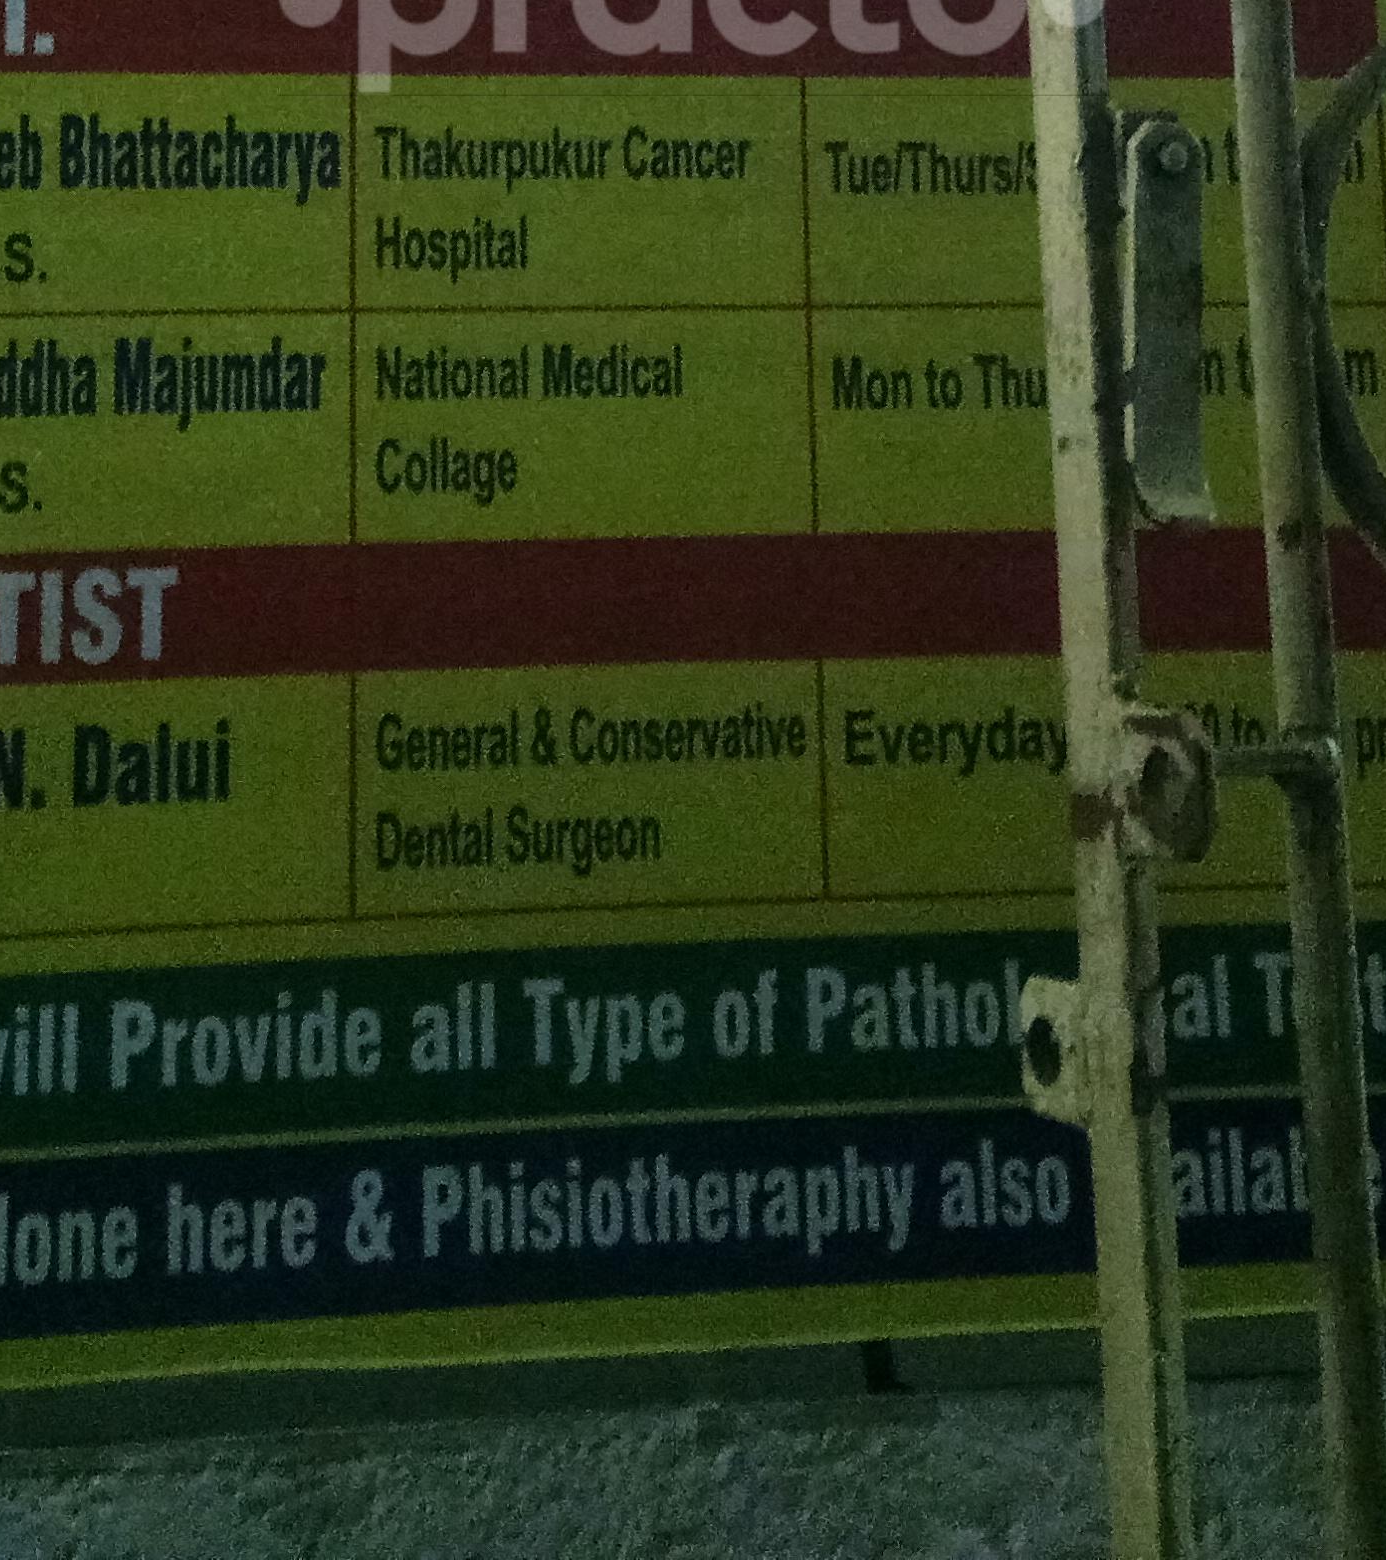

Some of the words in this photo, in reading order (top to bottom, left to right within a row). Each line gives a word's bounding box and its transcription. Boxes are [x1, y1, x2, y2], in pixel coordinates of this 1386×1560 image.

[59, 112, 341, 207] Bhattacharya
[374, 126, 612, 191] Thakurpukur
[622, 126, 751, 180] Cancer
[375, 217, 528, 282] Hospital
[113, 336, 326, 434] Majumdar
[375, 345, 529, 400] National
[541, 344, 683, 400] Medical
[832, 354, 913, 409] Mon
[925, 359, 963, 408] to
[974, 353, 1047, 408] Thu
[1344, 348, 1379, 396] m
[376, 439, 518, 506] Collage
[73, 717, 231, 808] Dalui
[376, 706, 518, 771] General
[532, 707, 557, 765] &
[568, 701, 806, 763] Conservative
[844, 706, 1067, 777] Everyday
[376, 806, 493, 871] Dental
[507, 805, 661, 876] Surgeon
[110, 988, 381, 1091] Provide
[413, 980, 496, 1073] all
[523, 978, 684, 1081] Type
[713, 969, 777, 1050] of
[806, 955, 1230, 1053] Patholal
[166, 1182, 318, 1275] here
[345, 1168, 394, 1265] &
[421, 1145, 915, 1258] Phisiotheraphy
[939, 1138, 1070, 1228] also
